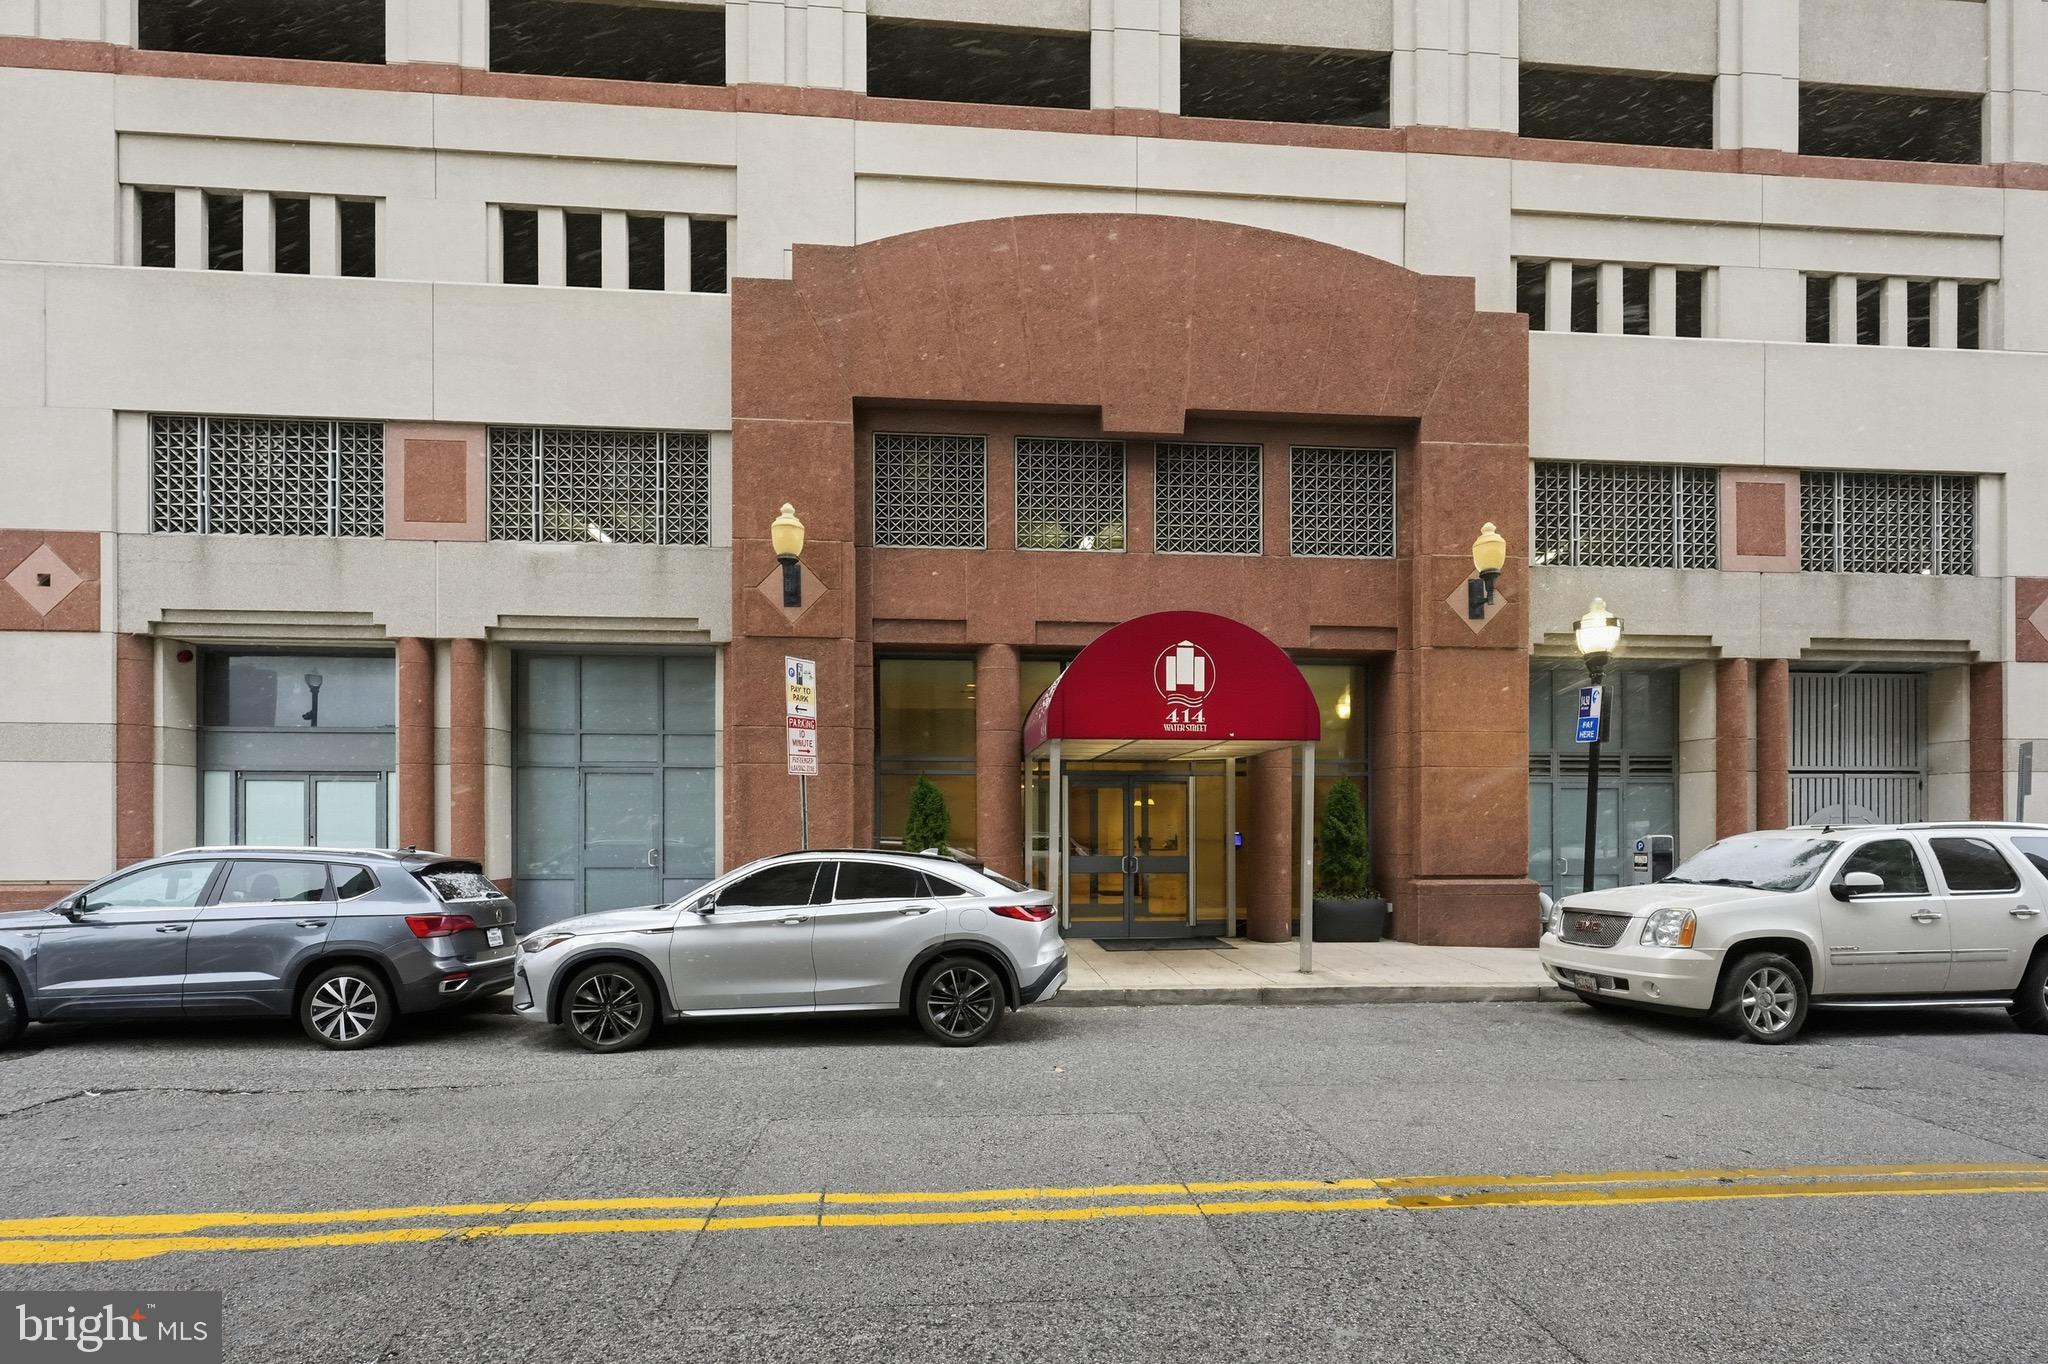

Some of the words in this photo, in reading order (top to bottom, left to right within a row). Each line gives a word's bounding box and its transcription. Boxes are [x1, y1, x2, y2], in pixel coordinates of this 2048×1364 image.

[790, 685, 801, 693] PAY
[803, 687, 811, 695] TO
[792, 694, 809, 703] PARK
[1165, 708, 1206, 723] 414
[788, 718, 815, 730] PARKING
[1163, 723, 1185, 732] WATER
[1186, 724, 1207, 732] STREET
[1582, 721, 1593, 729] PAY
[799, 730, 806, 738] 10
[792, 739, 813, 748] MINUTE
